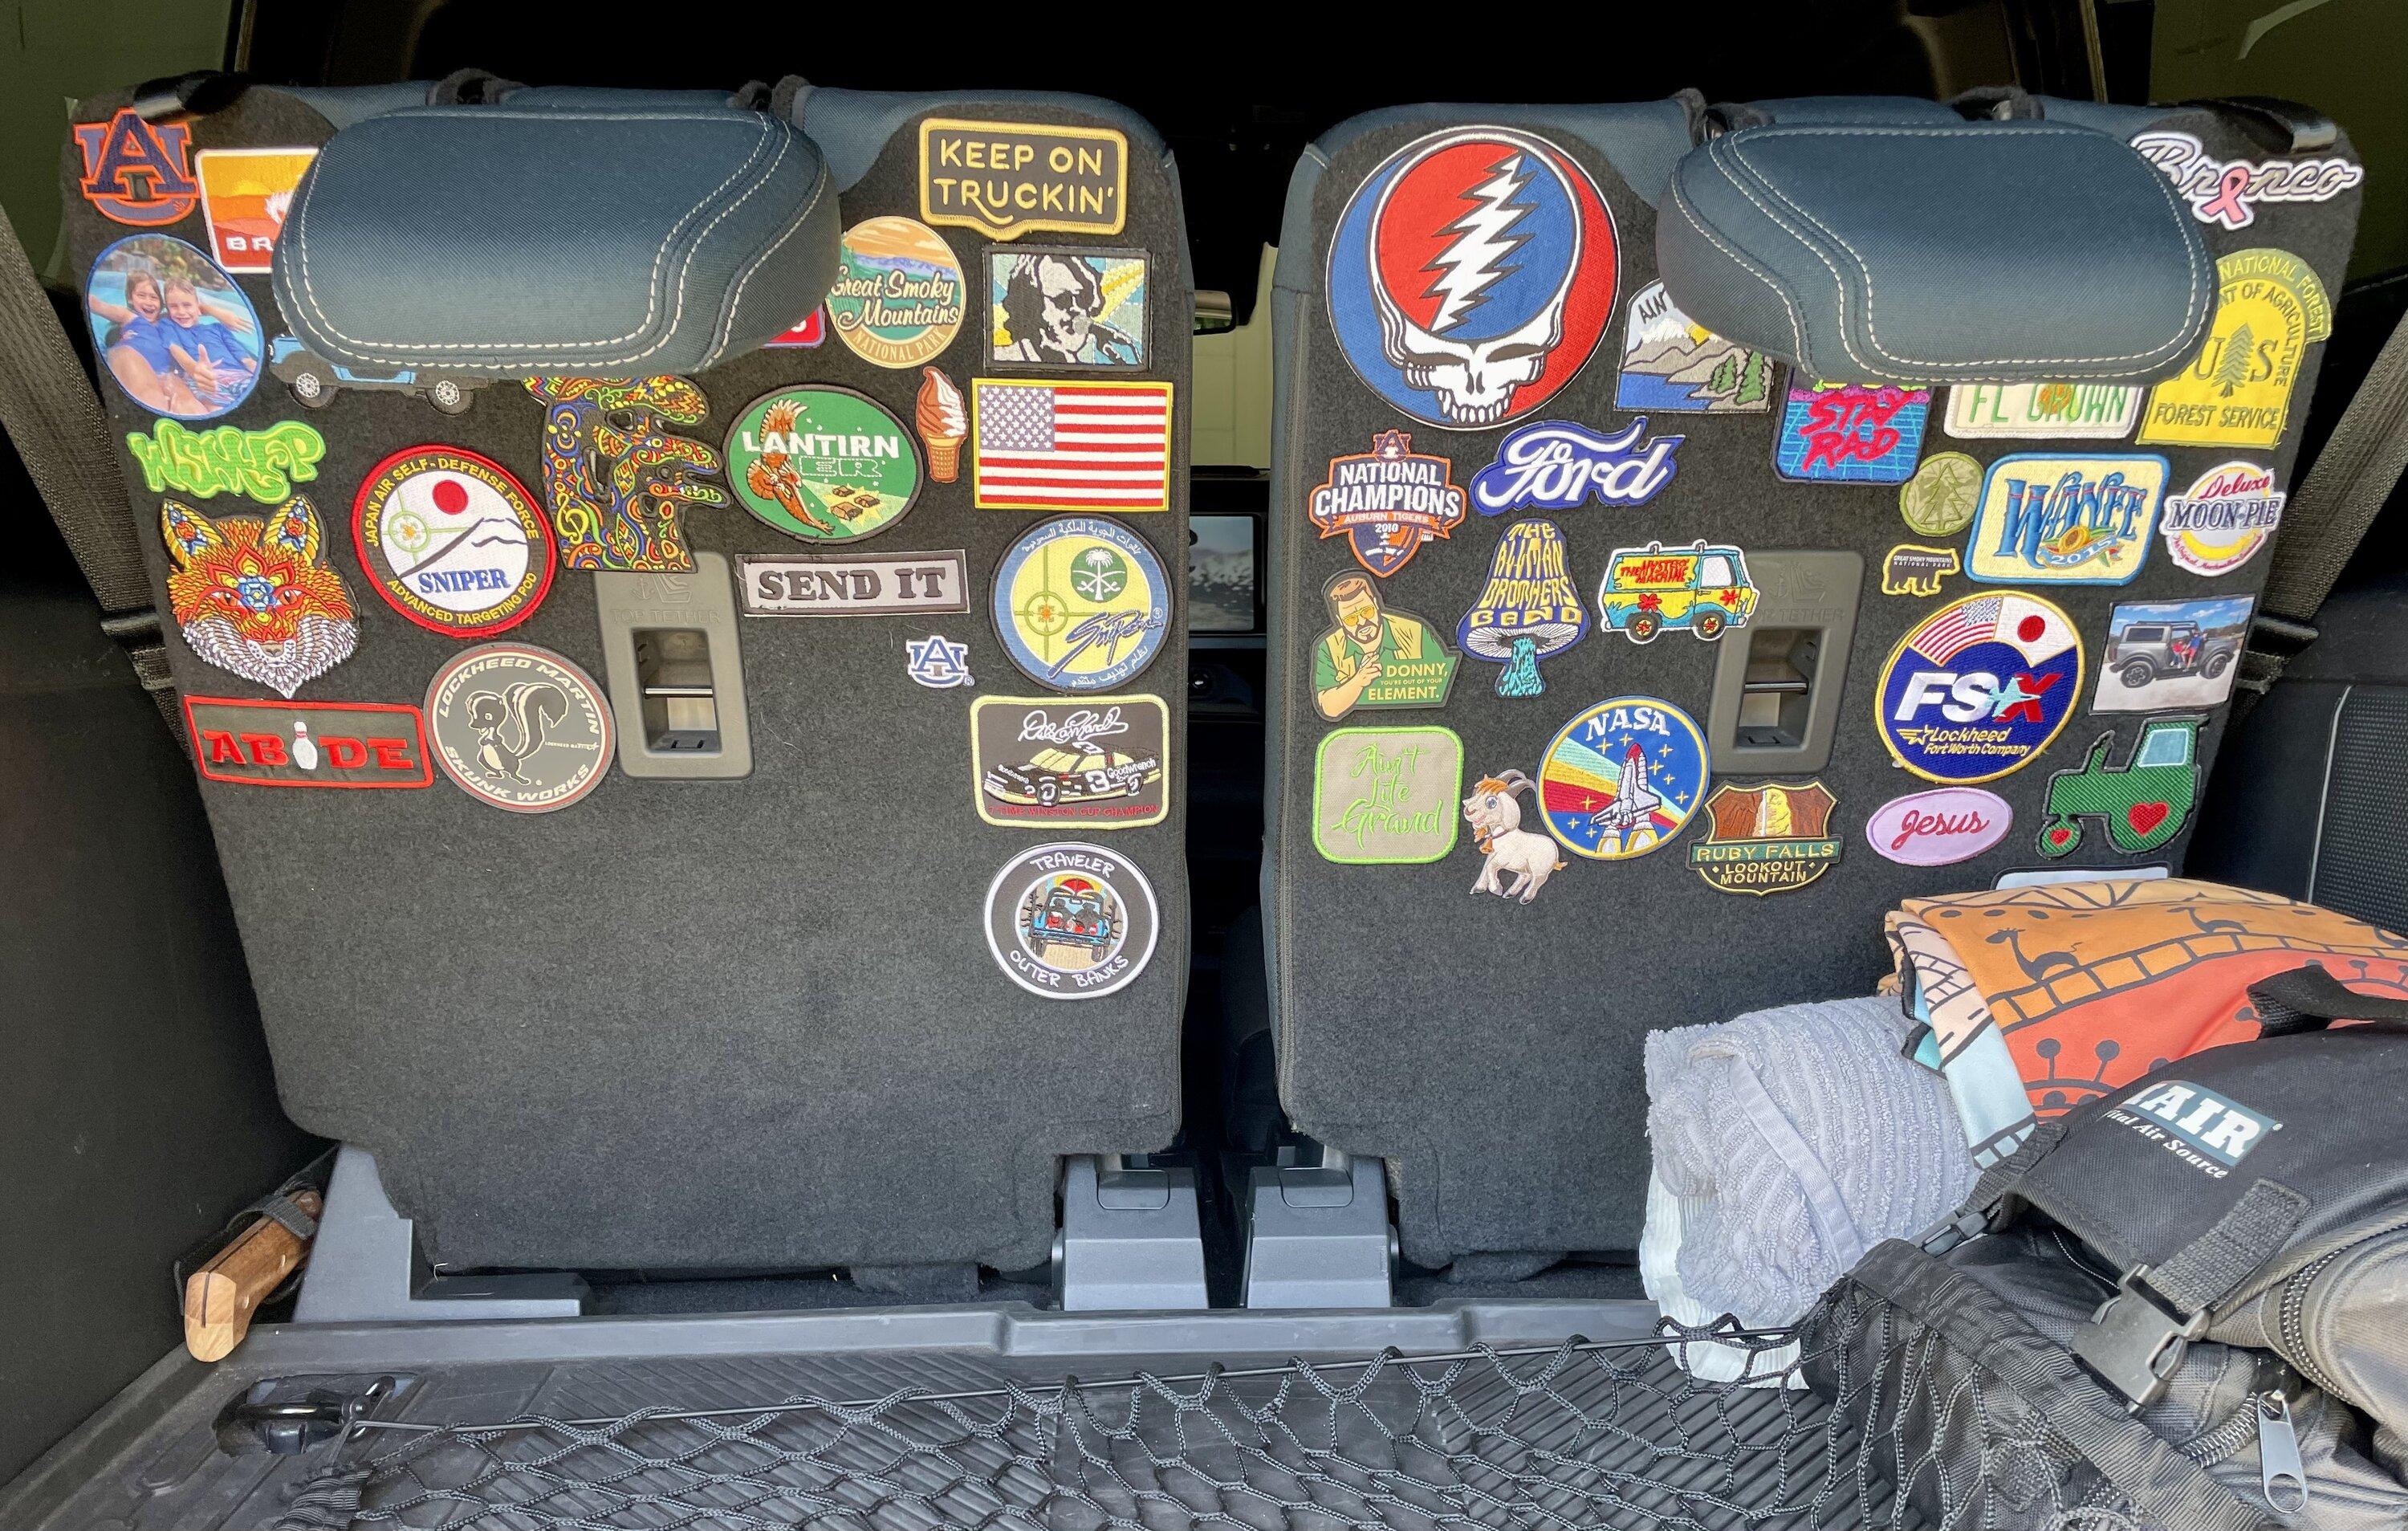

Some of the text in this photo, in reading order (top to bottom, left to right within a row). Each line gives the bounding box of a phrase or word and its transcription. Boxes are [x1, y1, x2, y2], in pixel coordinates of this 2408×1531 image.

[941, 138, 1102, 177] KEEP ON
[2136, 137, 2357, 197] Brnco
[934, 177, 1114, 226] TRUCKIN'
[831, 265, 955, 305] Great Smoky
[2219, 255, 2325, 334] NATIONAL FOREST
[837, 298, 959, 331] Mountains
[852, 328, 946, 361] NATIONAL PARK
[2241, 282, 2302, 387] OF AGRICULTURE
[2193, 336, 2279, 382] U S
[1799, 391, 1915, 437] STAY
[1968, 384, 2009, 423] FL
[2152, 402, 2281, 430] FOREST SERVICE
[742, 431, 900, 458] LANTIRN
[1801, 427, 1902, 472] RAD
[1340, 462, 1442, 487] NATIONAL
[1479, 423, 1673, 508] Ford
[372, 478, 396, 500] AIR
[1314, 484, 1461, 518] CHAMPIONS
[2198, 472, 2272, 500] Deluxe
[364, 500, 382, 548] JAPAN
[505, 491, 539, 540] FORCE
[1344, 511, 1430, 523] AUBURN TIGERS
[1374, 523, 1399, 534] 2010
[1507, 523, 1556, 542] THE
[1494, 537, 1566, 579] ALLMAN
[2051, 535, 2114, 564] 2015
[417, 568, 511, 594] SNIPER
[758, 567, 946, 601] SEND IT
[1476, 575, 1580, 611] BROTHERS
[386, 572, 538, 625] ADVANCED TARGETING POD
[651, 609, 721, 625] TETHER
[1470, 605, 1583, 629] BAND
[1386, 662, 1448, 678] DONNY,
[438, 657, 600, 735] LOCKHEED MARTIN
[1368, 686, 1440, 701] ELEMENT.
[1893, 671, 2064, 723] FSX
[1585, 706, 1670, 742] NASA
[1929, 726, 2013, 743] Lockheed
[1923, 742, 2032, 757] Fort Worth Company
[444, 745, 590, 801] SKUNK WORKS
[1084, 769, 1111, 793] 3
[1107, 757, 1157, 779] Goodwrench
[1027, 805, 1076, 817] WINSTON
[1079, 806, 1101, 816] CUP
[1103, 804, 1159, 817] CHAMPION
[1329, 797, 1444, 851] Grand
[1890, 809, 1991, 851] Jesus
[1029, 852, 1116, 879] TRAVELER
[1696, 844, 1836, 862] RUBY FALLS
[1724, 860, 1806, 875] LOOKOUT
[1720, 870, 1807, 885] MOUNTAIN
[1009, 950, 1129, 988] OUTER BANKS
[2122, 1083, 2260, 1158] AIR
[2105, 1110, 2229, 1179] ital Air Source
